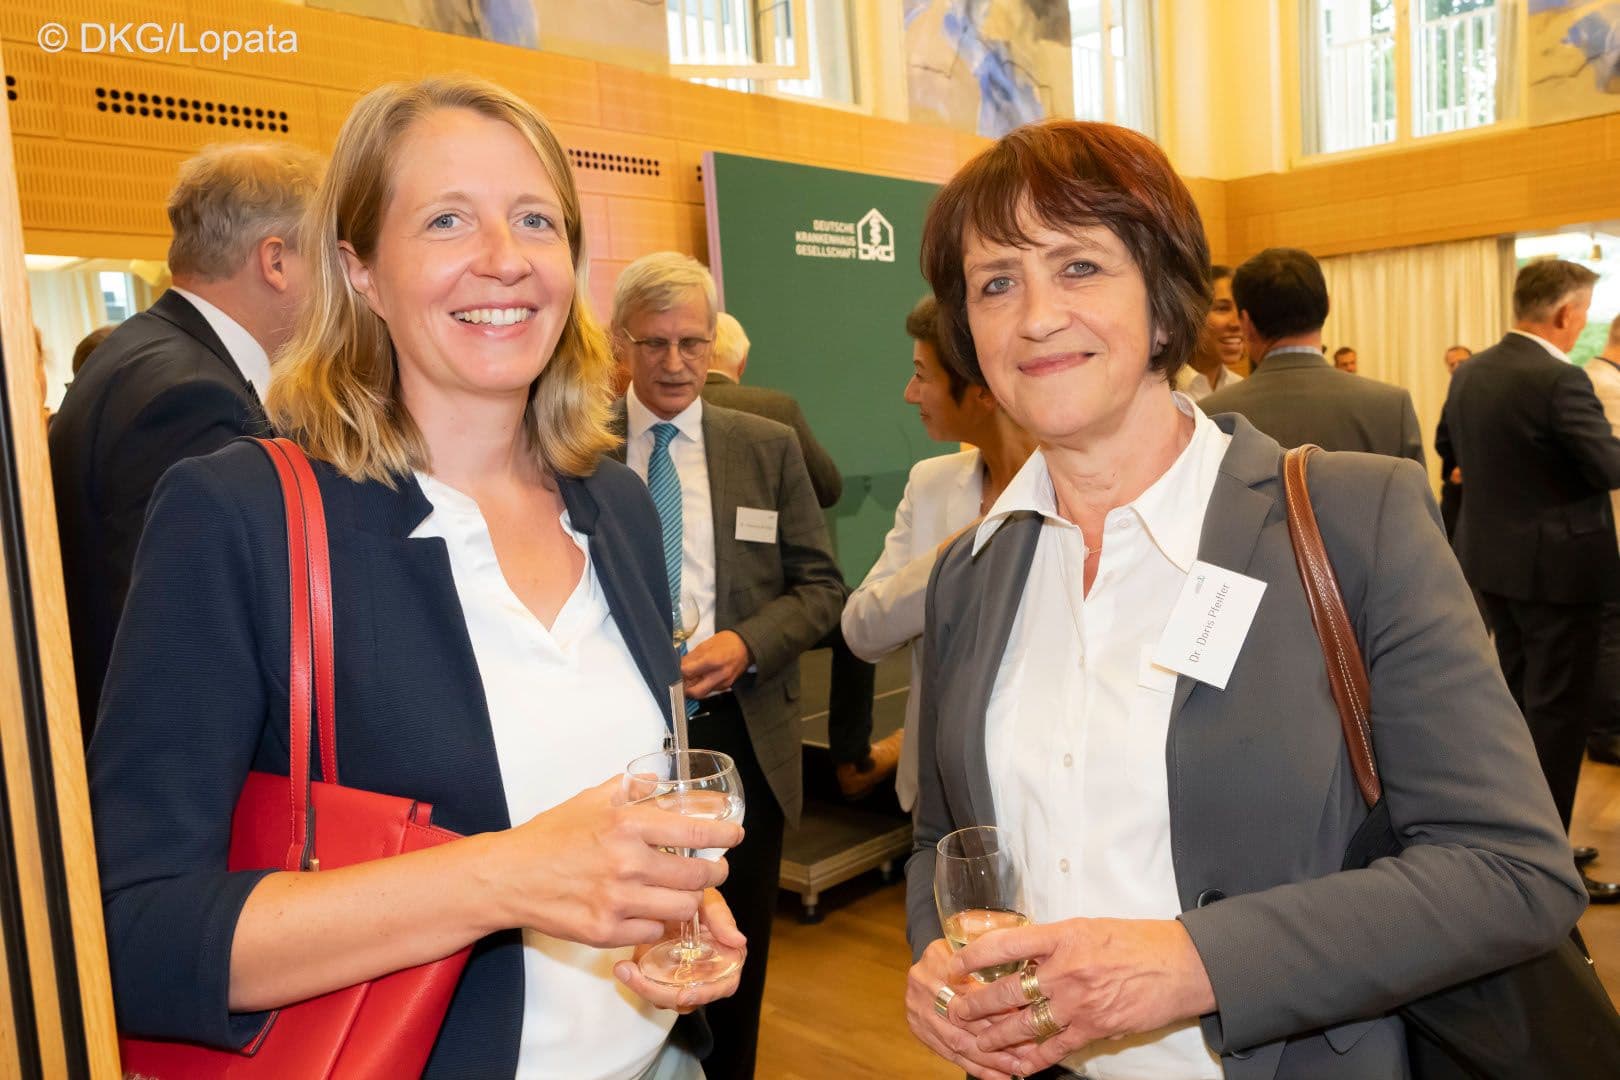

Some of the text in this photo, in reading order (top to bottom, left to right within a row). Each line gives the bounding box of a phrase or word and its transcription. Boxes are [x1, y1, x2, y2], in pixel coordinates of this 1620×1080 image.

[813, 219, 855, 234] DEUTSCHE
[795, 230, 857, 247] KRANKENHAUS
[795, 244, 857, 259] GESELLSCHAFT
[1188, 583, 1231, 663] Dr. Doris Pfeiffer
